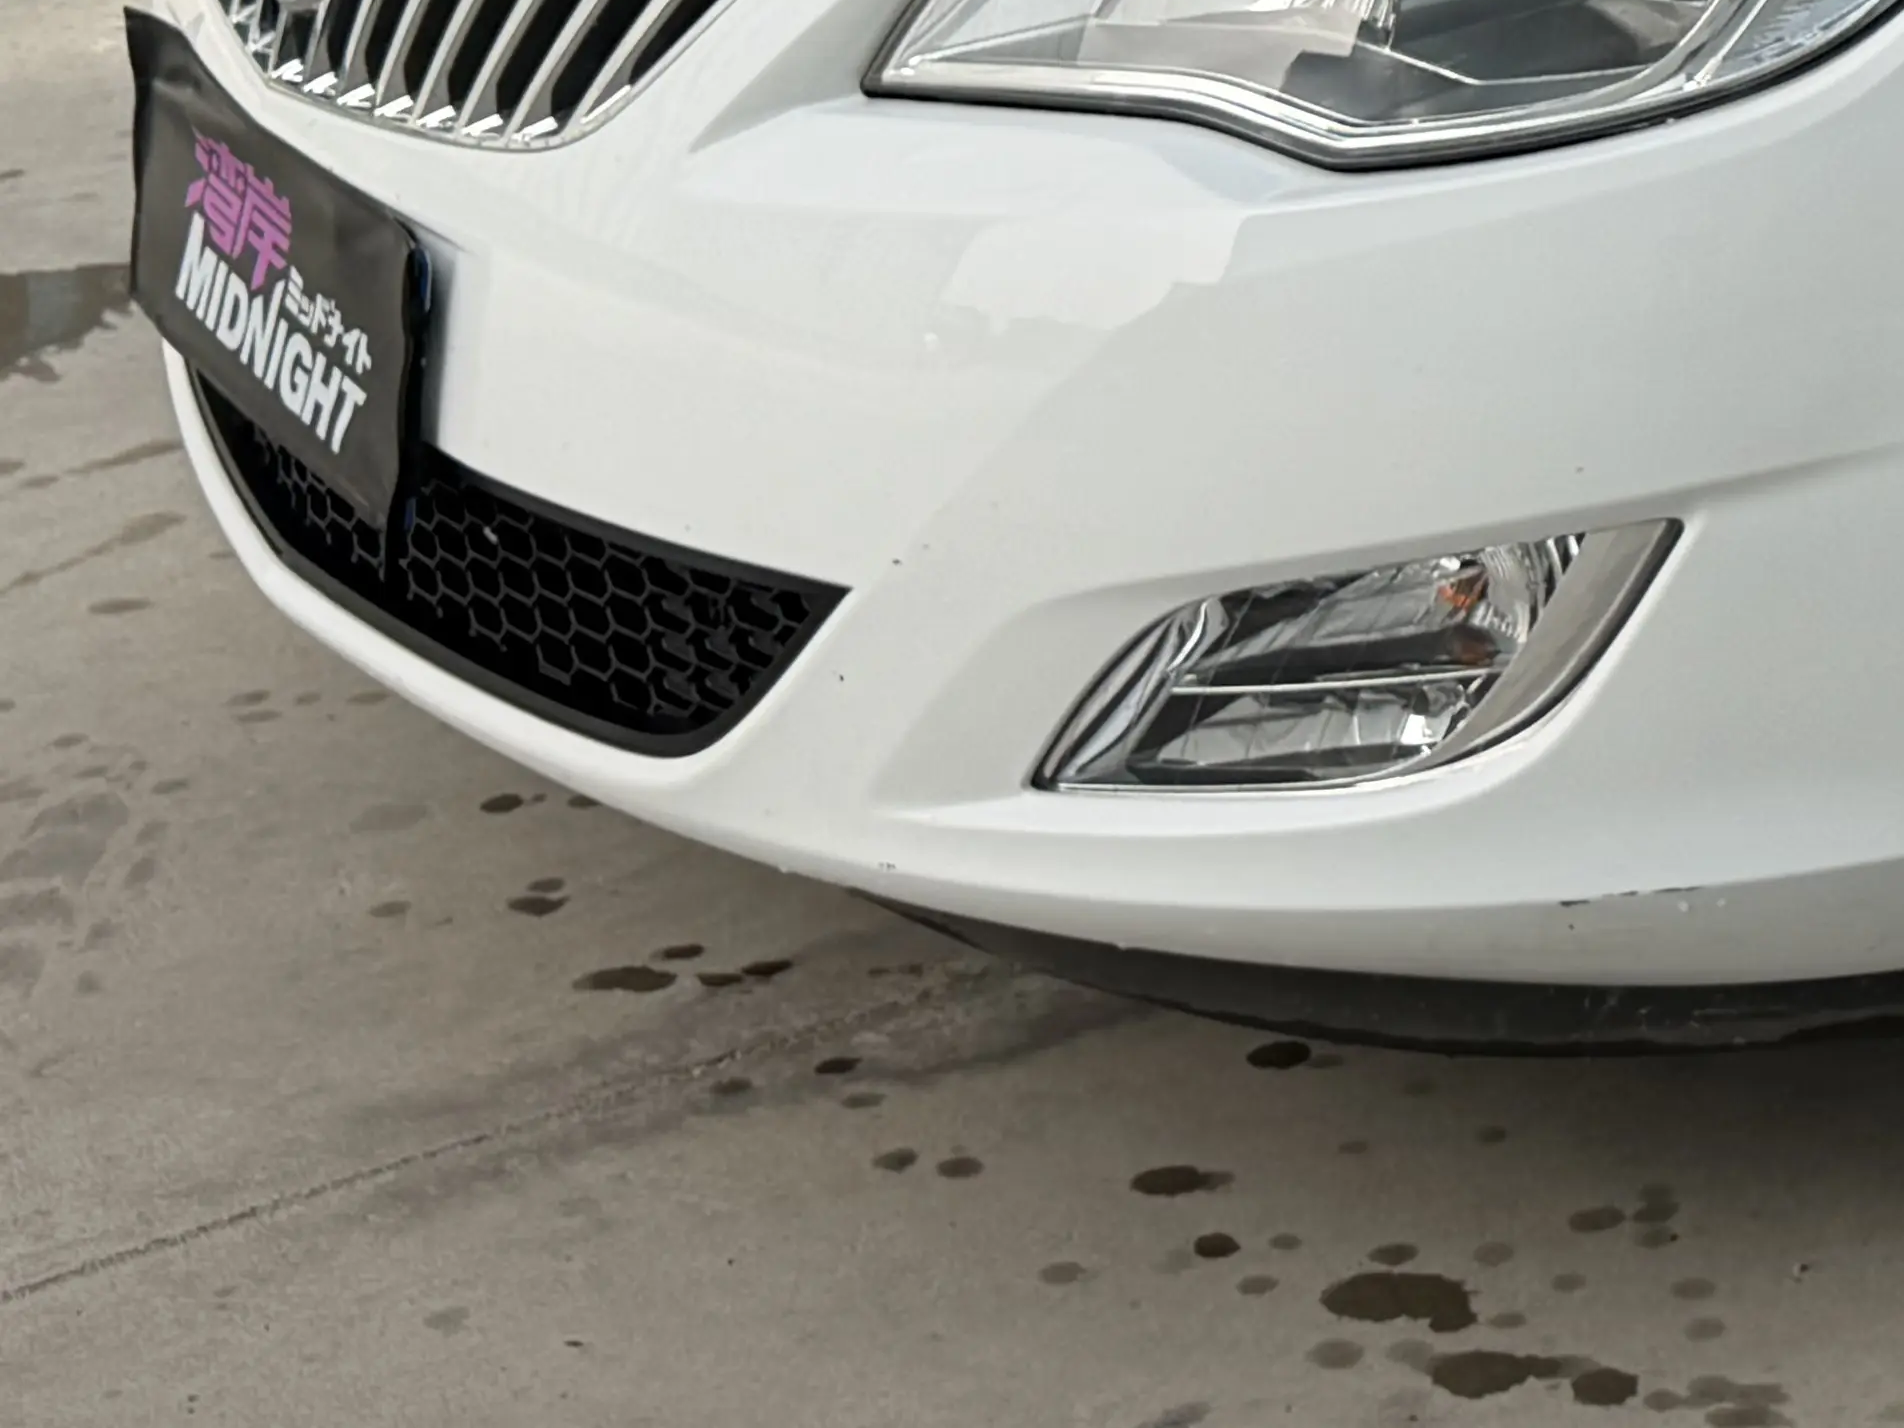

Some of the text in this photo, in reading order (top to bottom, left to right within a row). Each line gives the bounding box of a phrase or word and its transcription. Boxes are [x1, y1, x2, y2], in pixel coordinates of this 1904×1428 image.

[174, 210, 368, 455] MIDNIGHT
[284, 265, 373, 374] ミッドナイト
